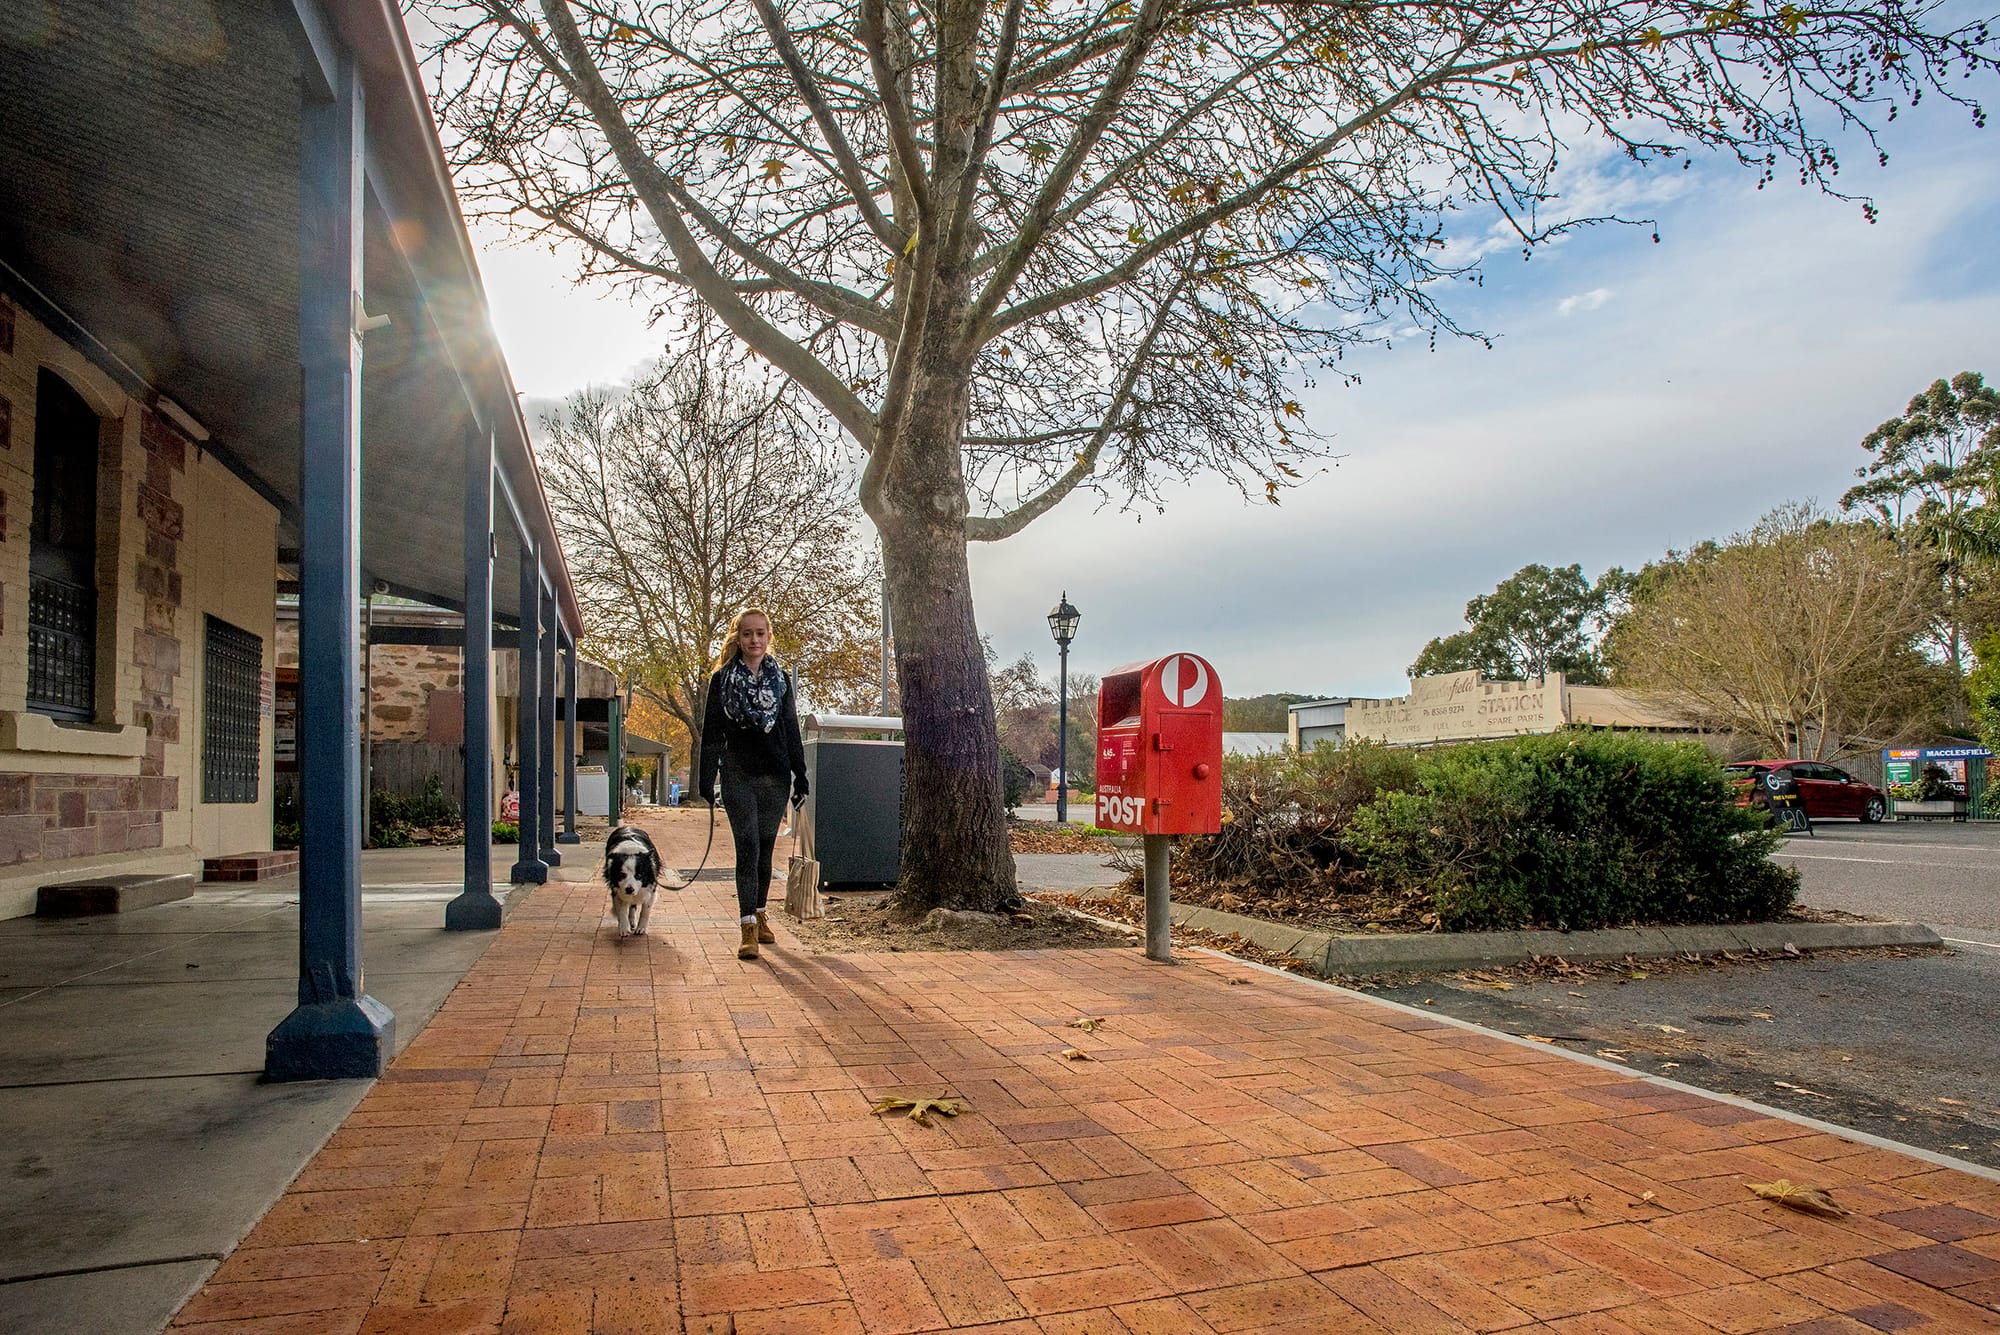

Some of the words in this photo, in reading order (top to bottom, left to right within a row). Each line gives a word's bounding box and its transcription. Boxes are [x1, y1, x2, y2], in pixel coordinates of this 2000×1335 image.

[1478, 693, 1543, 714] STATION
[1487, 716, 1513, 726] SPARE
[1517, 713, 1544, 723] PARTS
[1926, 748, 1992, 757] MACCLESFIELD
[1099, 784, 1122, 794] AUSTRALIA
[1098, 795, 1146, 826] POST
